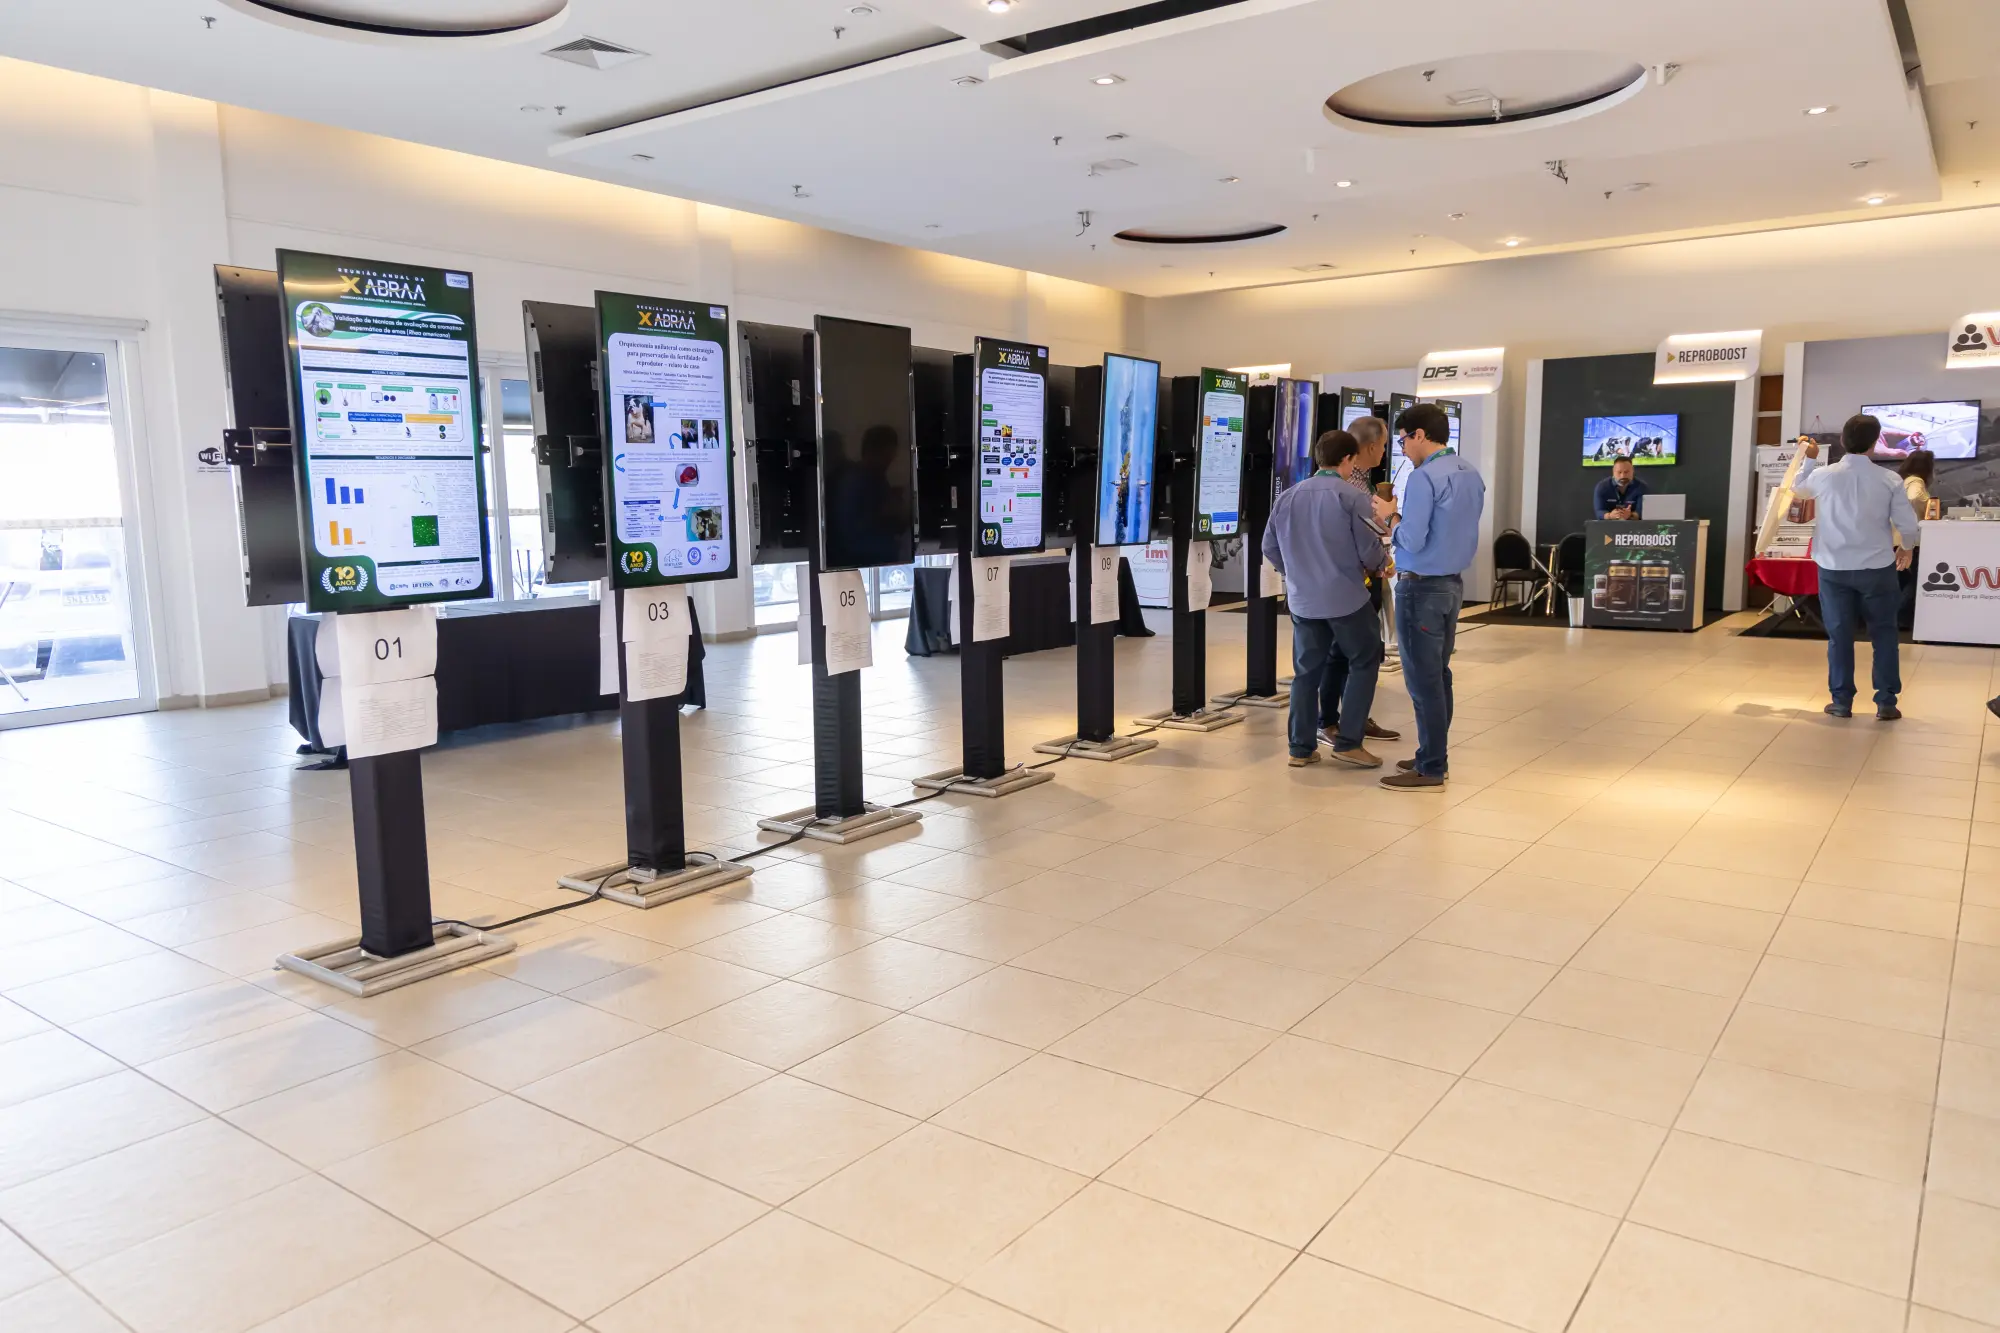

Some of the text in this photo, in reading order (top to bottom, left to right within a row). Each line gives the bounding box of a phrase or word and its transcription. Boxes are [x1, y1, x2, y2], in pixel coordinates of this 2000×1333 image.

[338, 267, 377, 277] REUNIÃO
[382, 273, 410, 281] ANUAL
[340, 275, 361, 294] X
[364, 278, 426, 301] ABRAA
[334, 315, 363, 324] Validação
[372, 318, 395, 326] técnicas
[404, 321, 429, 329] avaliação
[638, 311, 652, 326] X
[654, 313, 696, 331] ABRAA
[349, 325, 382, 334] espermática
[998, 351, 1030, 366] X ABRAA
[1679, 347, 1747, 363] REPROBOOST
[1615, 534, 1677, 546] REPROBOOST
[629, 551, 644, 563] 10
[1101, 557, 1111, 570] 09
[335, 566, 355, 580] 10
[987, 567, 999, 581] 07
[335, 579, 356, 587] ANOS
[839, 590, 856, 607] 05
[648, 602, 669, 621] 03
[375, 637, 402, 660] 01
